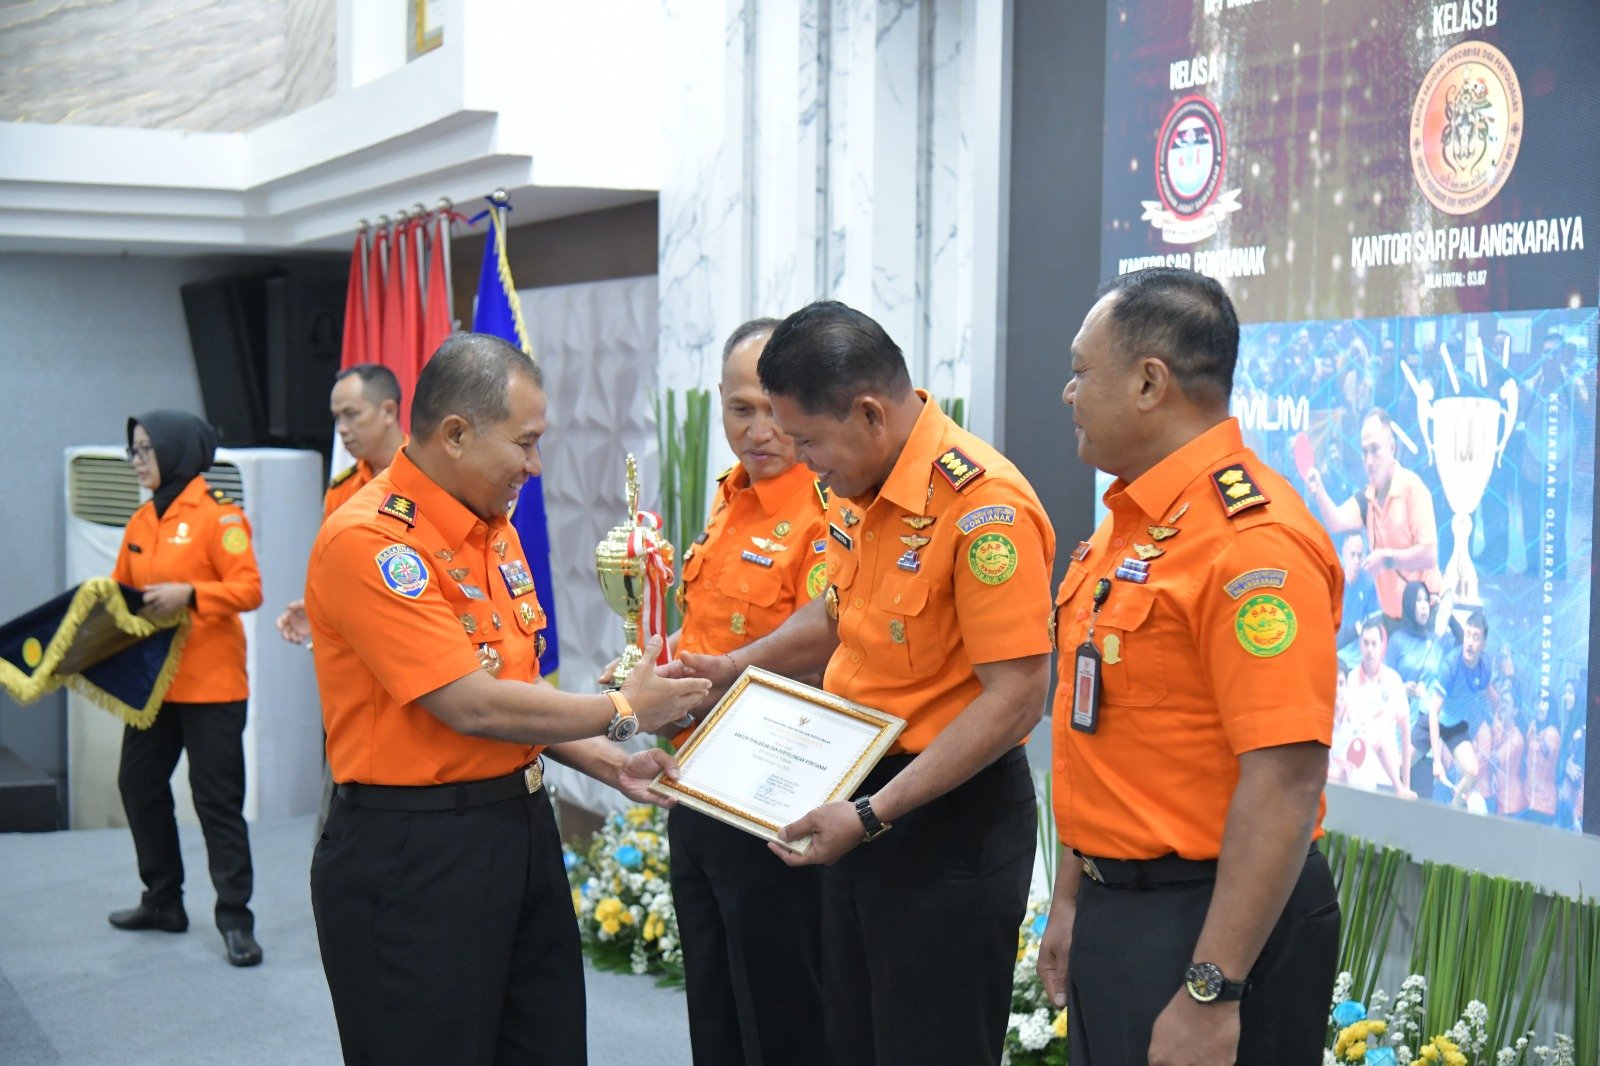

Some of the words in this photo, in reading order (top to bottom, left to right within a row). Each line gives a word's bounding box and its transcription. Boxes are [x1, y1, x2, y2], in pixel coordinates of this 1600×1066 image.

[1433, 0, 1483, 37] KELAS
[1486, 0, 1497, 26] B
[1170, 56, 1207, 90] KELAS
[1208, 54, 1218, 82] A
[1352, 232, 1412, 268] KANTOR
[1413, 229, 1447, 263] SAR
[1449, 216, 1584, 260] PALANGKARAYA
[1547, 392, 1558, 499] KEJUARAAN
[963, 513, 1011, 531] PONTIANAK
[980, 543, 1001, 554] SAR
[1543, 508, 1555, 604] OLAHRAGA
[1251, 605, 1277, 618] SAR
[1540, 615, 1552, 712] BASARNAS
